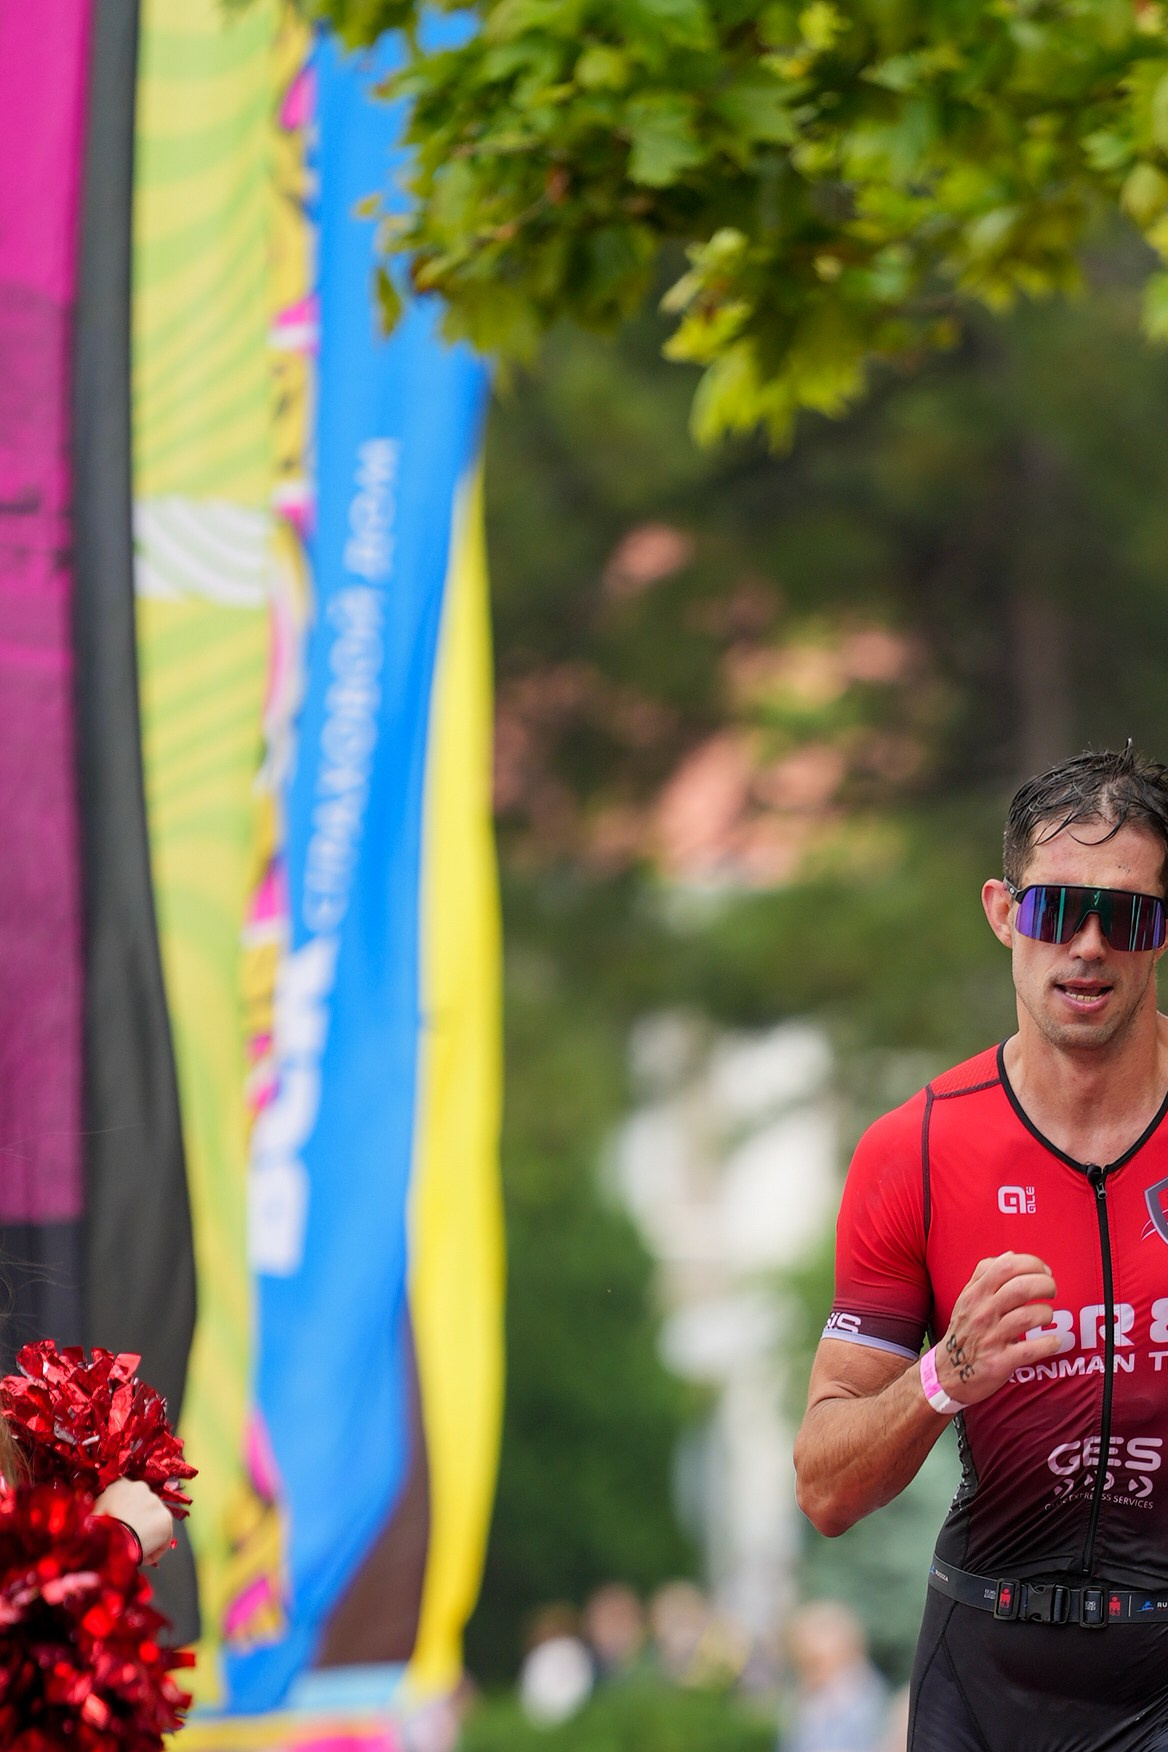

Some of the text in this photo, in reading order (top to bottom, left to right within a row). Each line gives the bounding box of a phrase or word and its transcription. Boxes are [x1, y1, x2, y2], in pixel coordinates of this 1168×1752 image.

[1025, 1303, 1135, 1356] BR
[1008, 1352, 1135, 1384] ONMAN
[1047, 1436, 1163, 1475] GES
[1113, 1495, 1154, 1510] SERVICES
